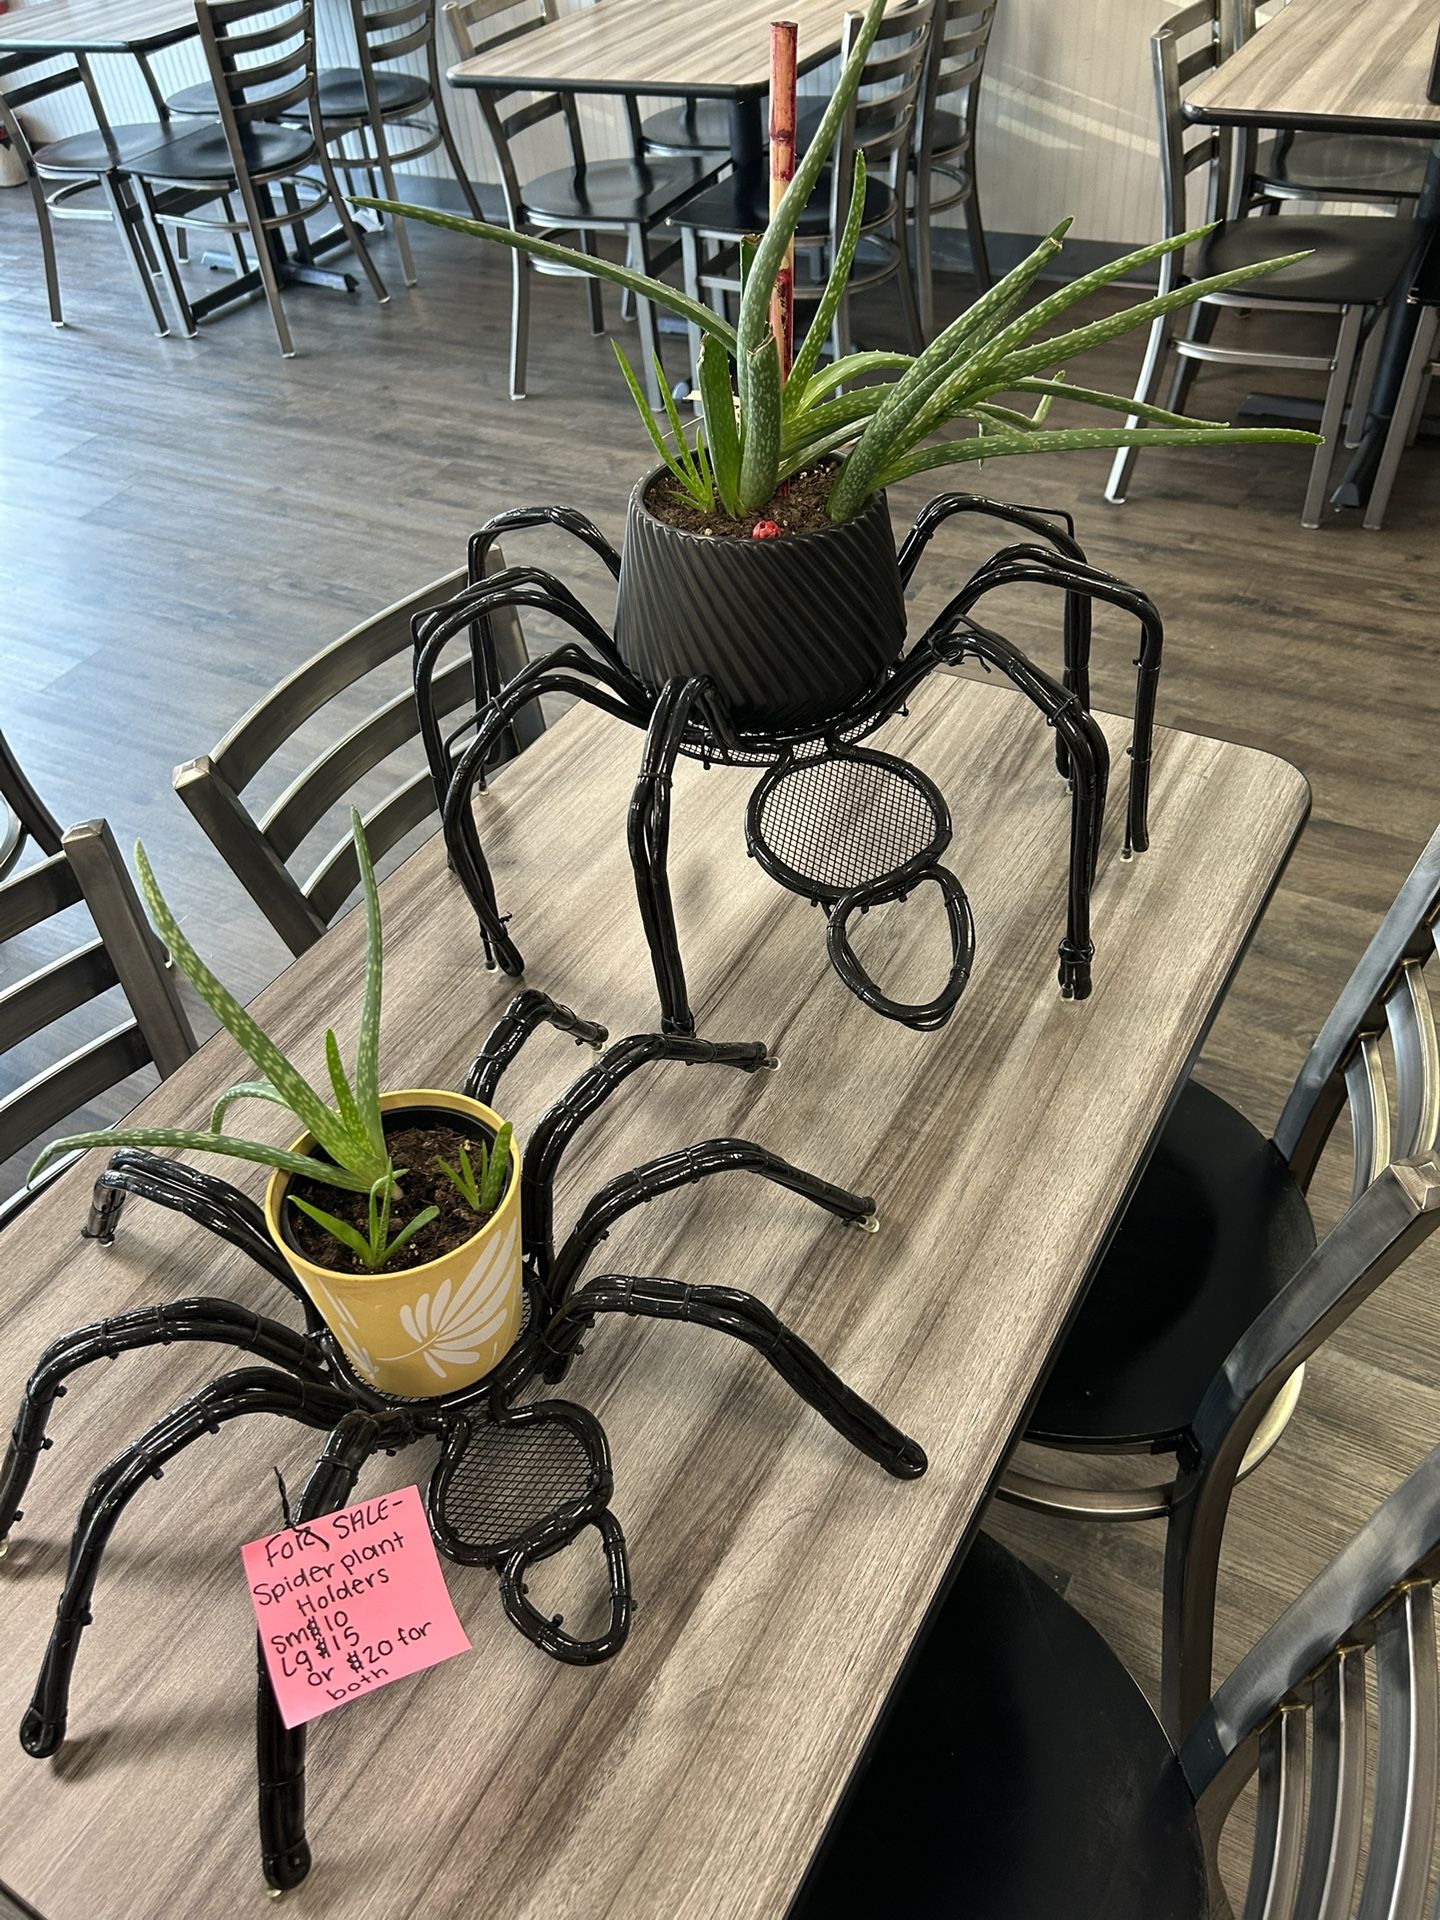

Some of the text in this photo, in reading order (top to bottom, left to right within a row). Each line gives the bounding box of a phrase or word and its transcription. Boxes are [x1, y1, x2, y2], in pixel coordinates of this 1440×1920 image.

[253, 1532, 404, 1606] Spider plant
[297, 1568, 389, 1617] Holders
[347, 1640, 393, 1673] $20
[397, 1622, 432, 1645] for
[326, 1668, 389, 1700] both
